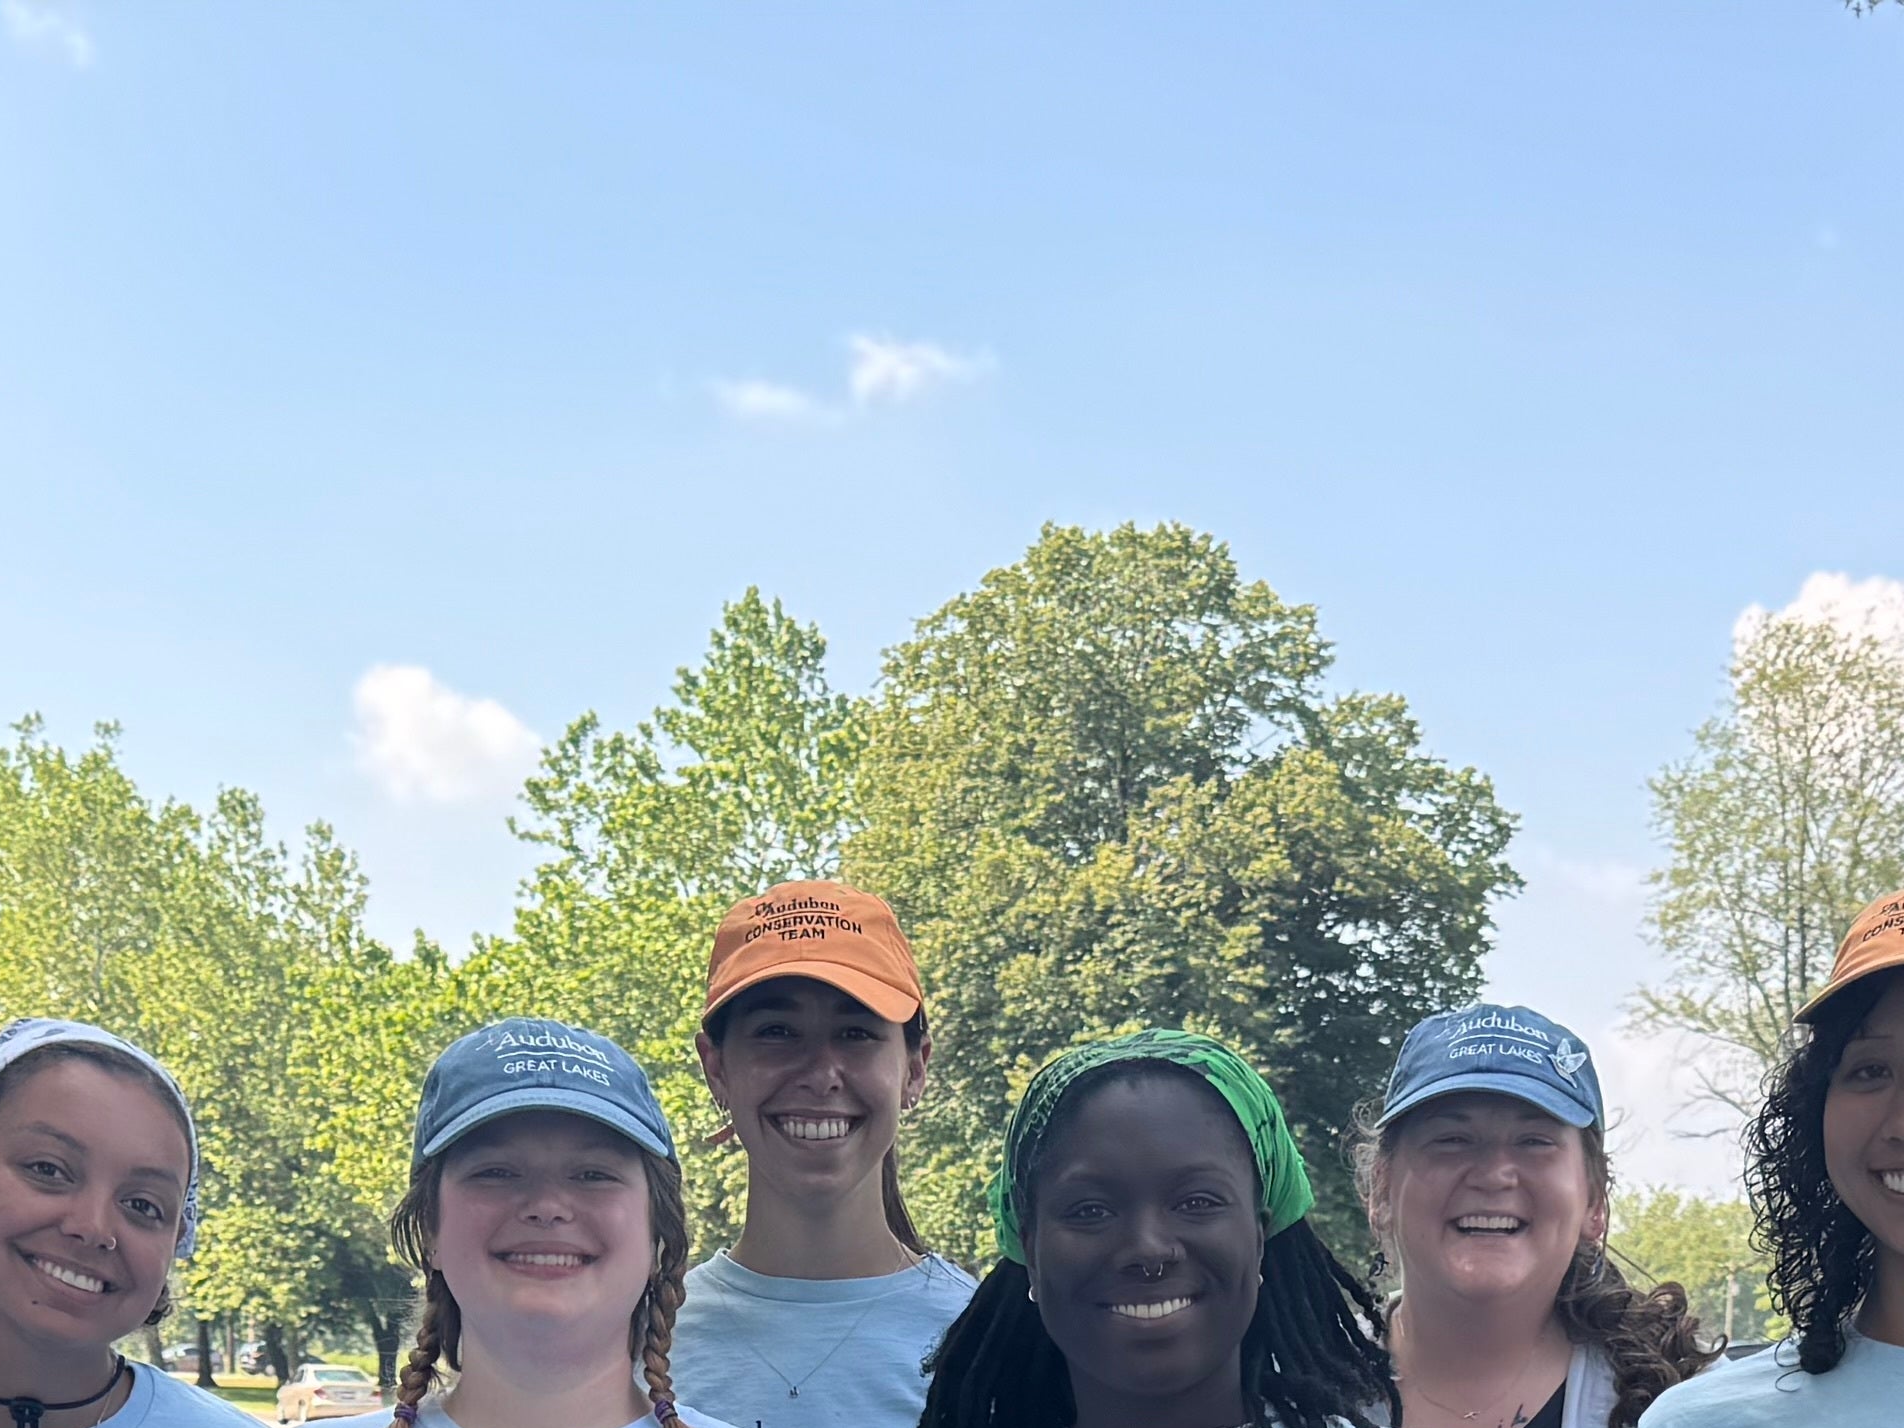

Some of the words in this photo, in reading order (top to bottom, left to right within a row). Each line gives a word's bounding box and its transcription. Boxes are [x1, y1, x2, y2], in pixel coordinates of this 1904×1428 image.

[763, 897, 840, 918] Audubon
[745, 915, 862, 943] CONSERVATION
[778, 927, 825, 941] TEAM
[1449, 1012, 1550, 1042] Audubon
[495, 1030, 610, 1064] Audubon
[1449, 1043, 1496, 1059] GREAT
[1499, 1044, 1543, 1064] LAKES
[504, 1060, 557, 1074] GREAT
[562, 1061, 610, 1086] LAKES
